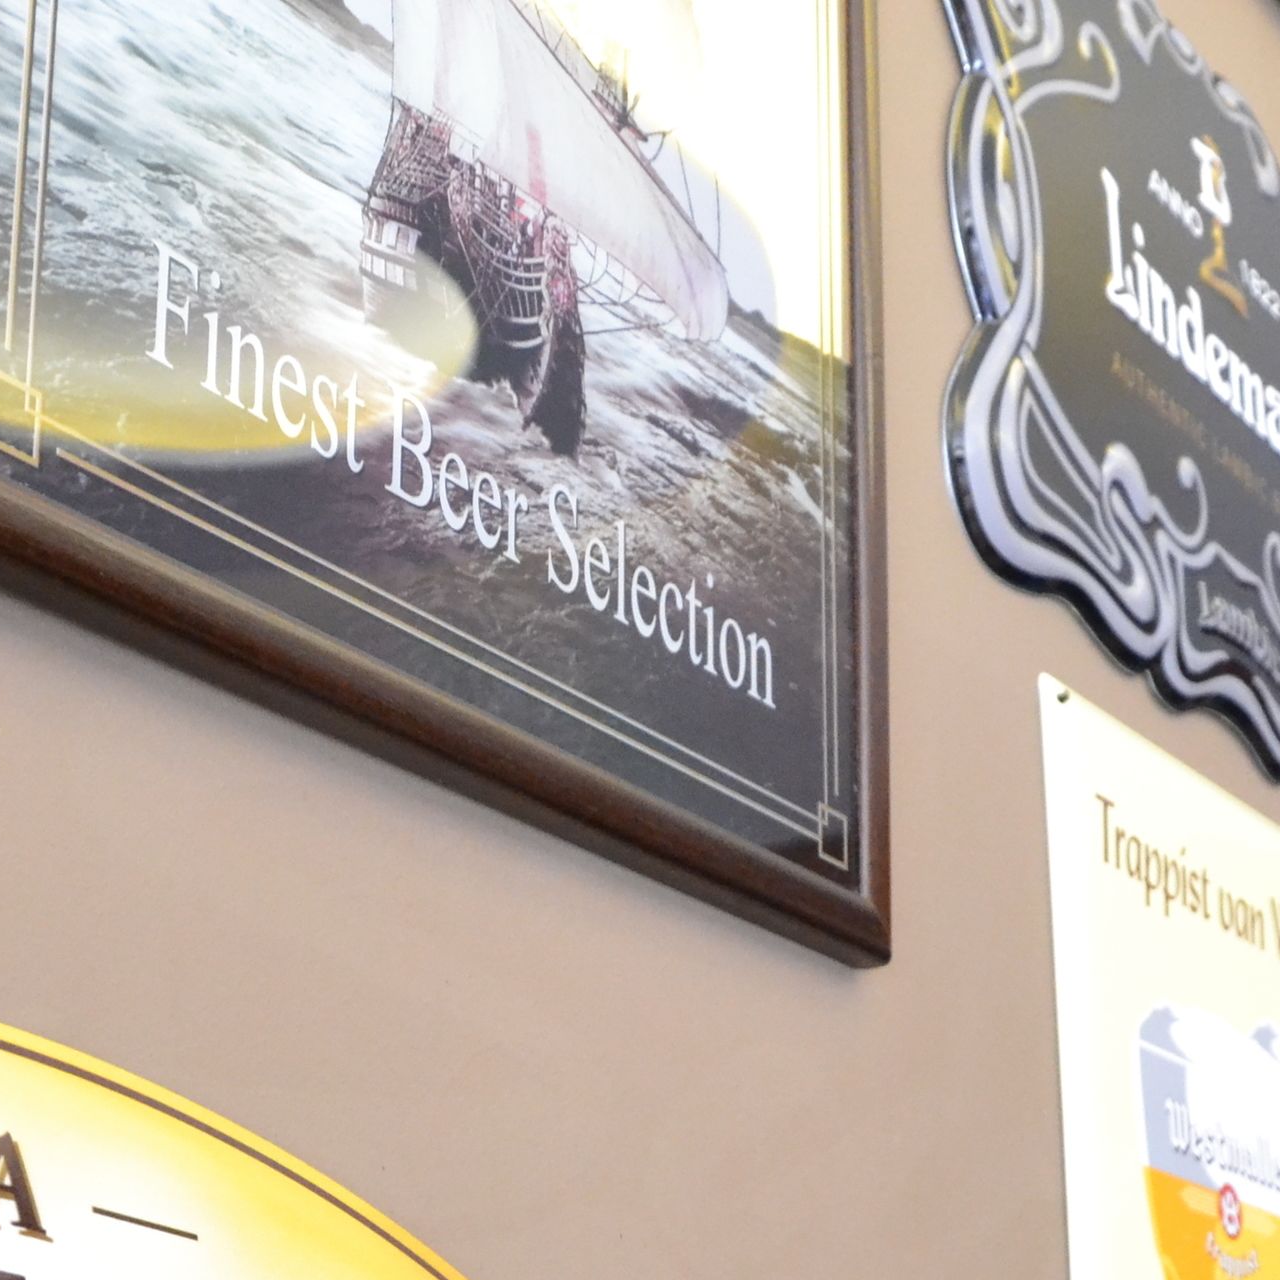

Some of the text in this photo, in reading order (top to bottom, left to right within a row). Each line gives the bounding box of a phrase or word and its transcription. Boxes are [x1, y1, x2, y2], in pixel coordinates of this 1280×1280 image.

[146, 239, 777, 711] Finest Beer Selection
[1095, 793, 1211, 921] Trappist
[1218, 885, 1266, 952] van
